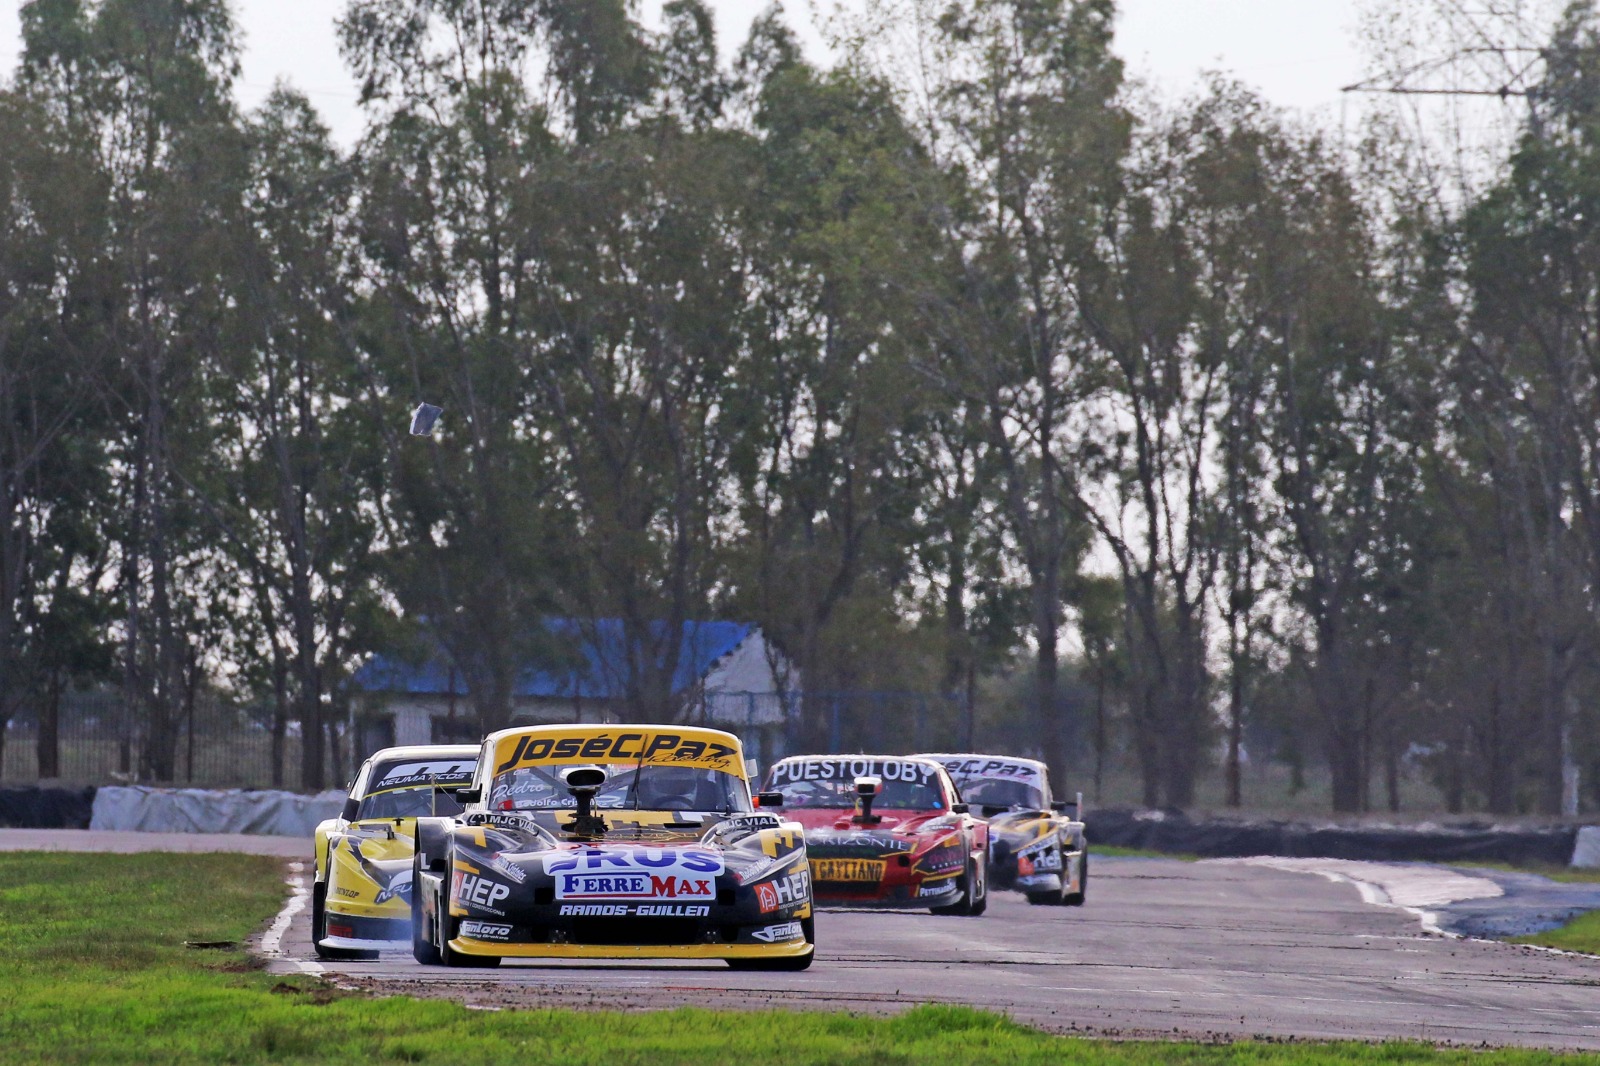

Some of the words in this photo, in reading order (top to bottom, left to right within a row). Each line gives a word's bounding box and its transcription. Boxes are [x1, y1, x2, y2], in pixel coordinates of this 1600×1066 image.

[376, 773, 467, 788] NEUMATICOS
[492, 781, 544, 804] Pedro
[489, 815, 516, 826] MJC
[518, 819, 535, 832] VIAL
[745, 817, 778, 826] VIAL
[459, 873, 510, 907] HEP
[771, 869, 809, 904] HEP
[559, 904, 710, 917] RAMOS-GUILLEN
